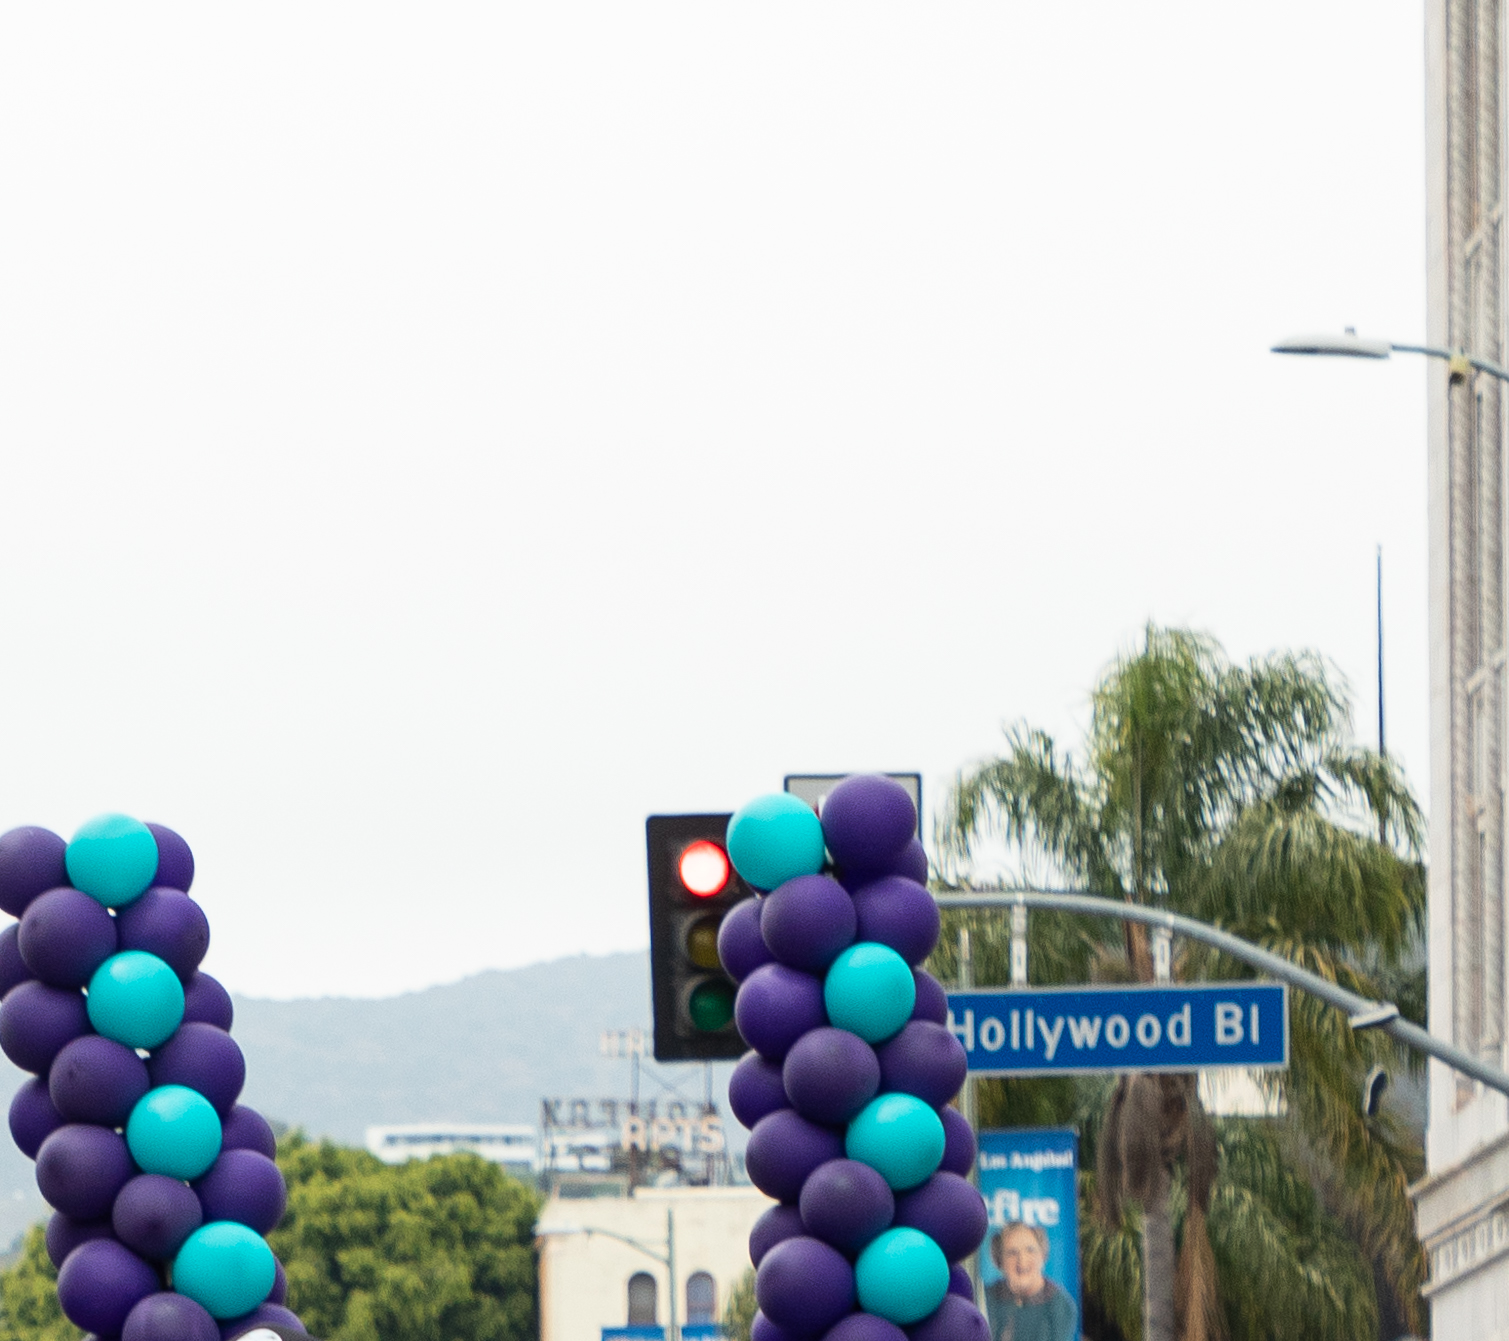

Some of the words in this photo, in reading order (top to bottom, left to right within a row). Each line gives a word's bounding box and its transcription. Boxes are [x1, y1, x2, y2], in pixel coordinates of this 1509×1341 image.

[946, 1001, 1193, 1061] Hollywood
[1214, 1002, 1260, 1046] Bl
[621, 1116, 727, 1151] APTS
